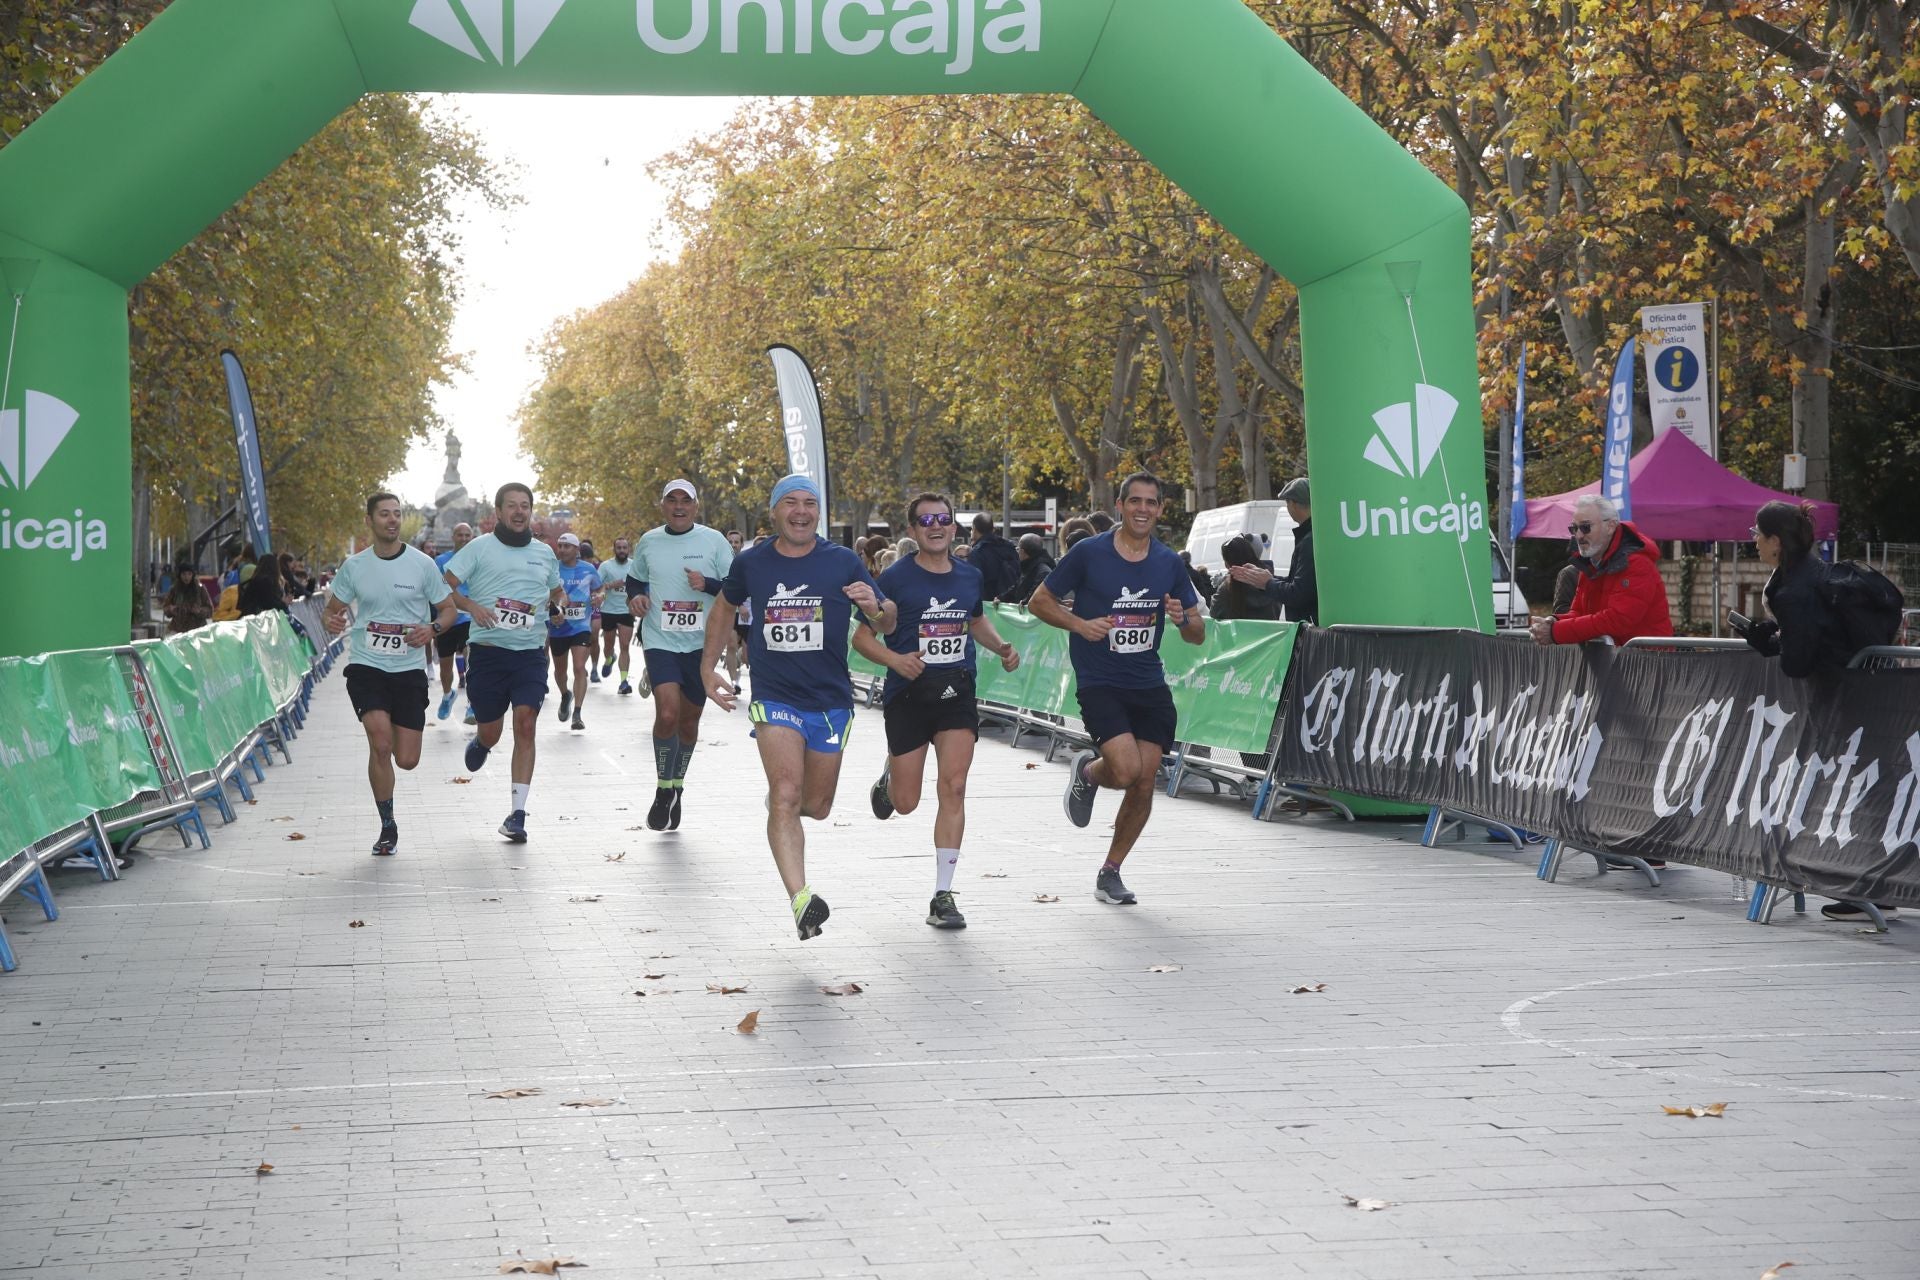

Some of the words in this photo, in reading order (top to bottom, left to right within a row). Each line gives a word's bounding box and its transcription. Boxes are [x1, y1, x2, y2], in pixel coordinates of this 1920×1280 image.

[636, 0, 1042, 75] Unicaja
[1649, 314, 1676, 323] Oficina
[1677, 313, 1687, 321] de
[1340, 492, 1483, 543] Unicaja
[2, 508, 107, 561] icaja
[767, 599, 822, 607] MICHELIN
[500, 609, 527, 626] 781
[667, 613, 697, 626] 780
[920, 612, 967, 620] MICHELIN
[372, 633, 402, 649] 779
[771, 624, 811, 643] 681
[1115, 629, 1150, 646] 680
[927, 638, 962, 656] 682
[771, 710, 790, 721] RAÚL
[1301, 666, 1356, 758] El
[1353, 667, 1459, 768] Norte
[1653, 697, 1735, 819] El
[1725, 695, 1880, 850] Norte
